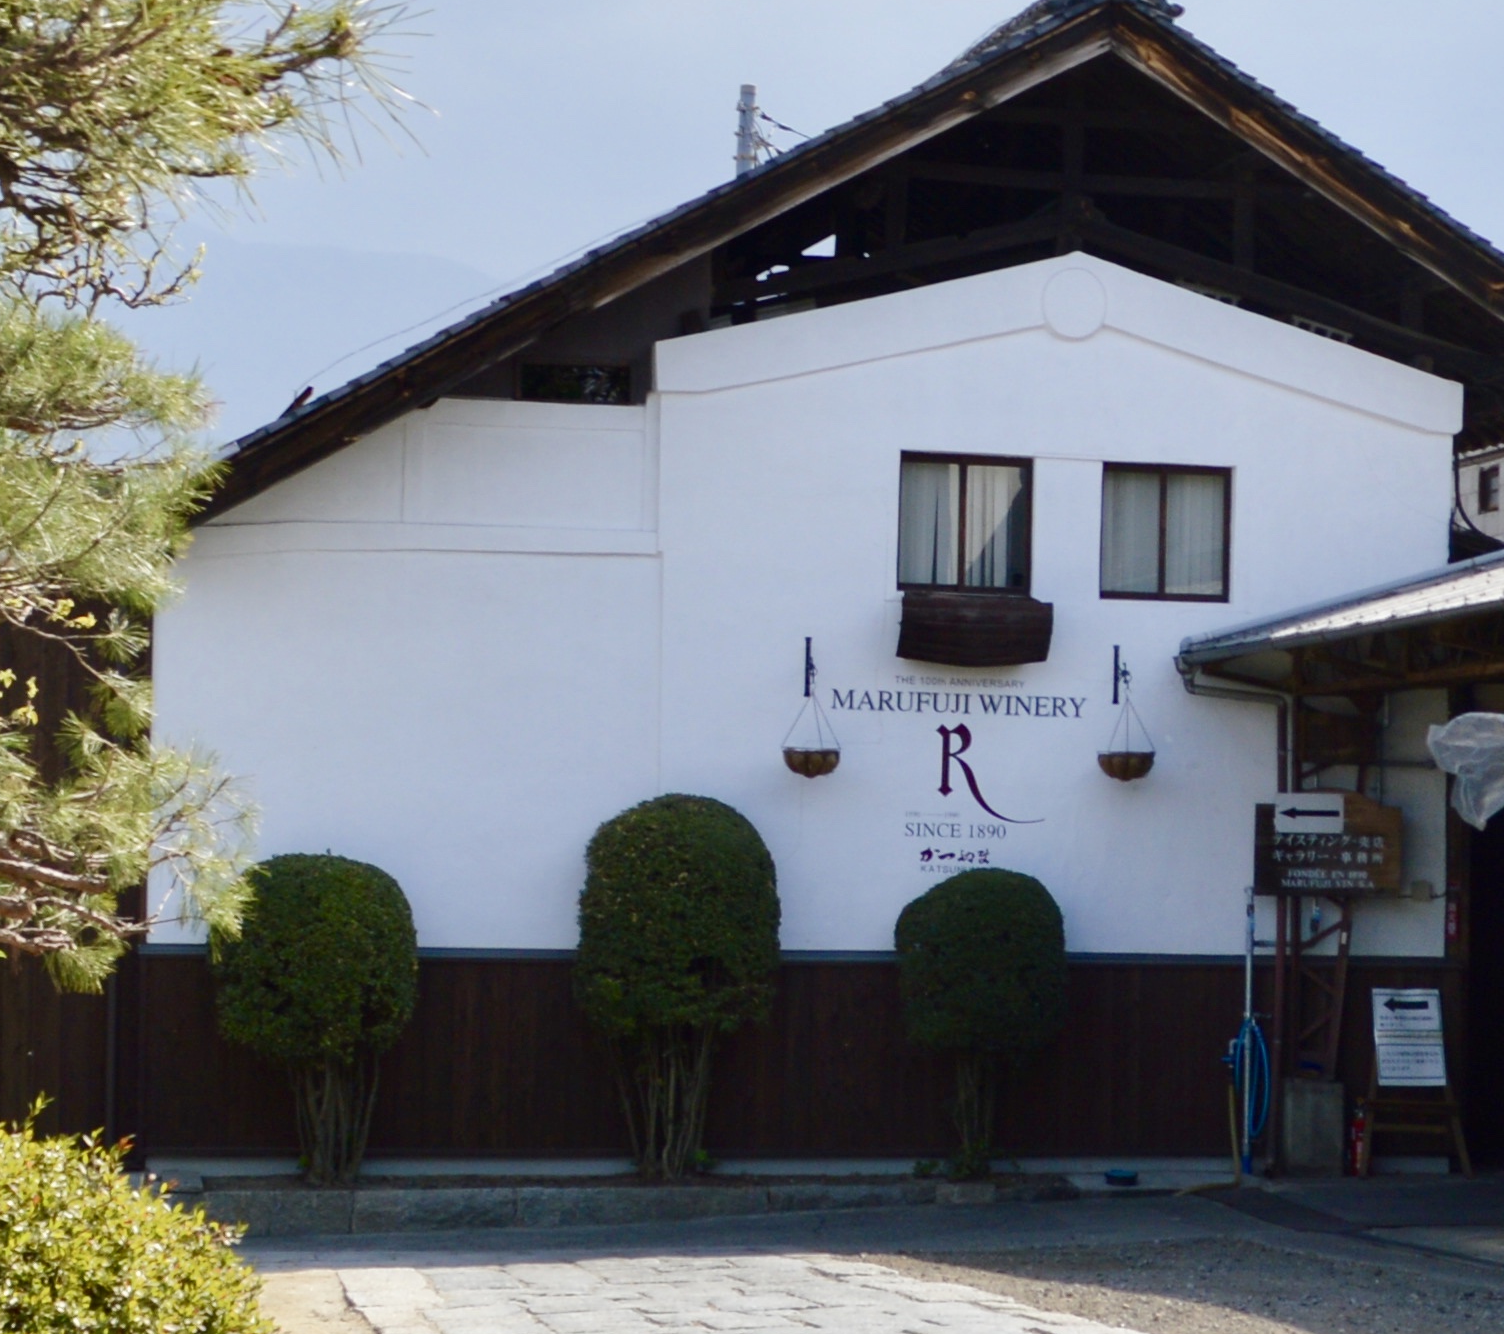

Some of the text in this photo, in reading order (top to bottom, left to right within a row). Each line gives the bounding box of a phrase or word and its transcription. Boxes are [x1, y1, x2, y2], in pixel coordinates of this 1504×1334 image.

[895, 675, 1026, 689] THE 100th ANNIVERSARY
[830, 688, 1087, 718] MARUFUJI WINERY
[904, 822, 1007, 840] SINCE 1890
